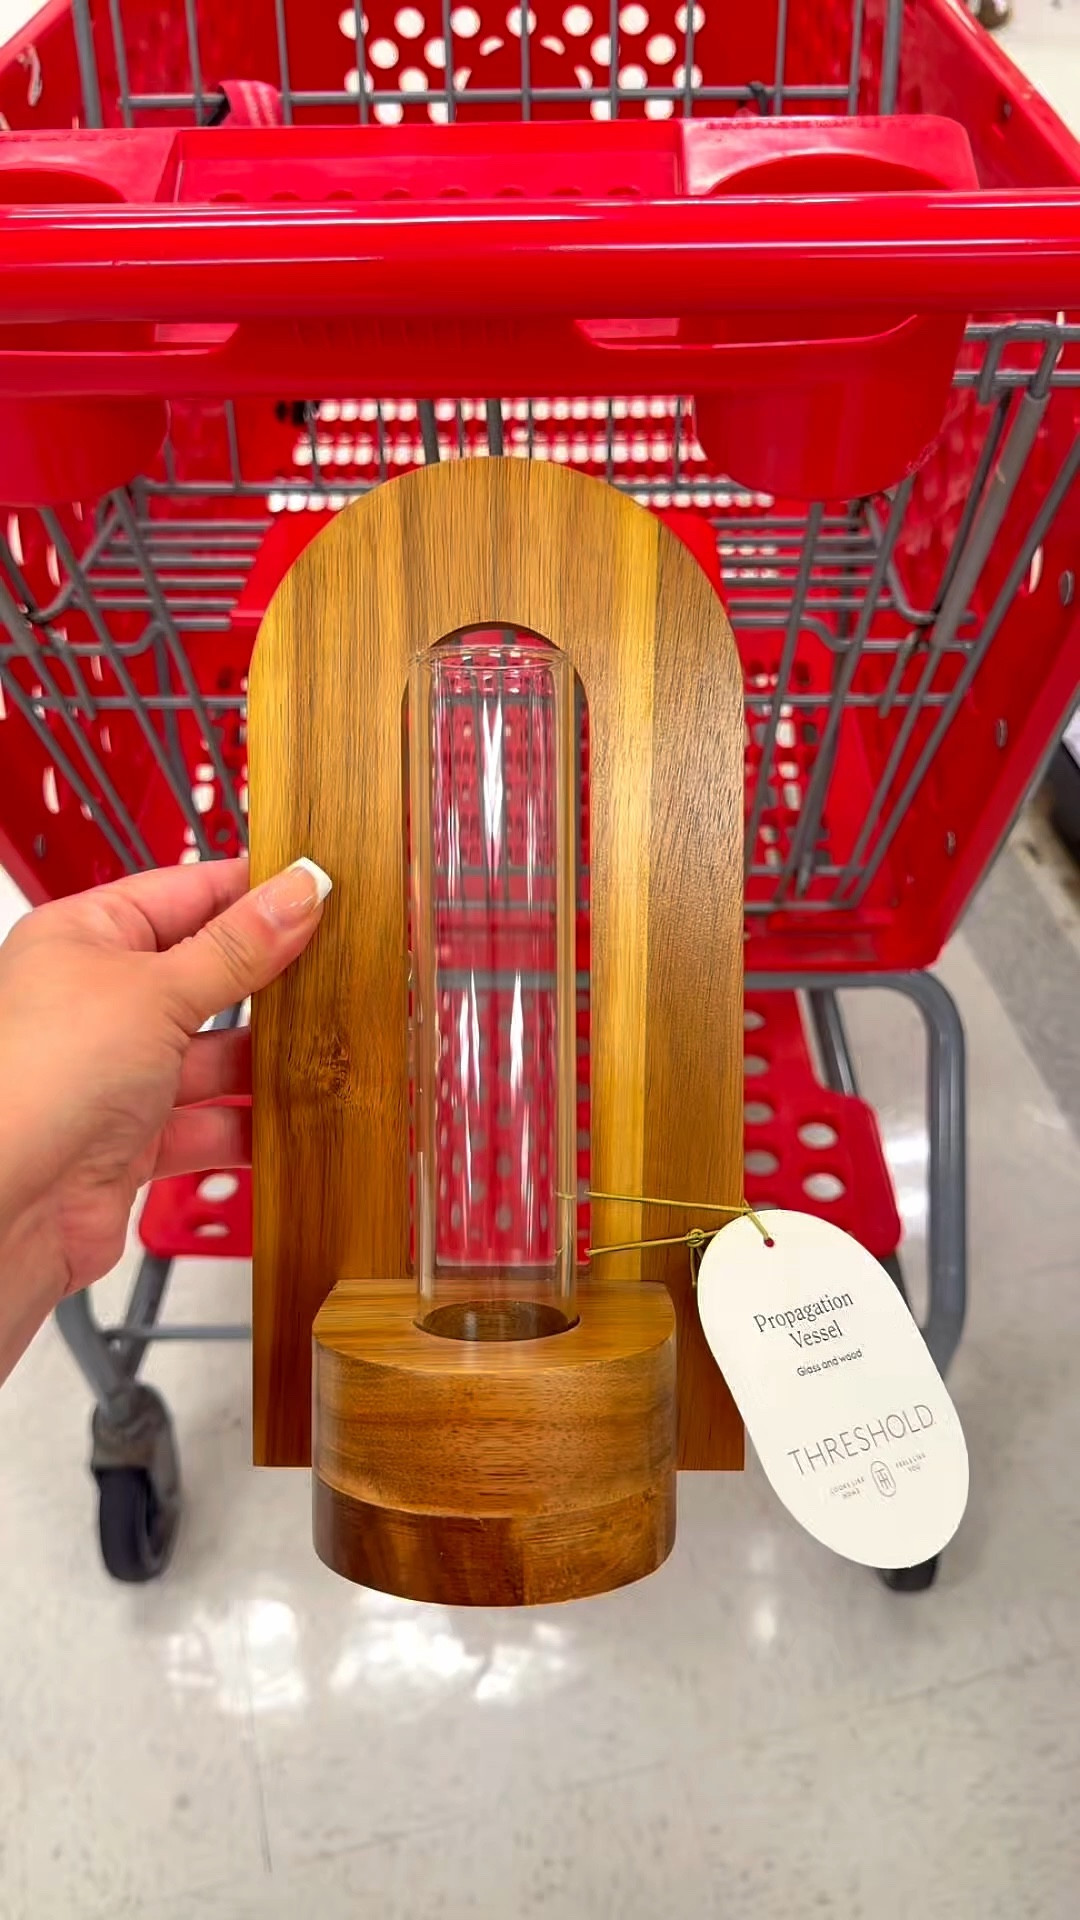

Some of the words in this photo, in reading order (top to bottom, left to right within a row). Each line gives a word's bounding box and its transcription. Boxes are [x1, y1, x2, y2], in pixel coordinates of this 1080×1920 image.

[753, 1292, 855, 1333] Propagation
[789, 1319, 844, 1348] Vessel
[796, 1361, 821, 1377] Glass
[822, 1357, 839, 1370] and
[839, 1348, 863, 1362] wood
[787, 1404, 935, 1476] THRESHOLD
